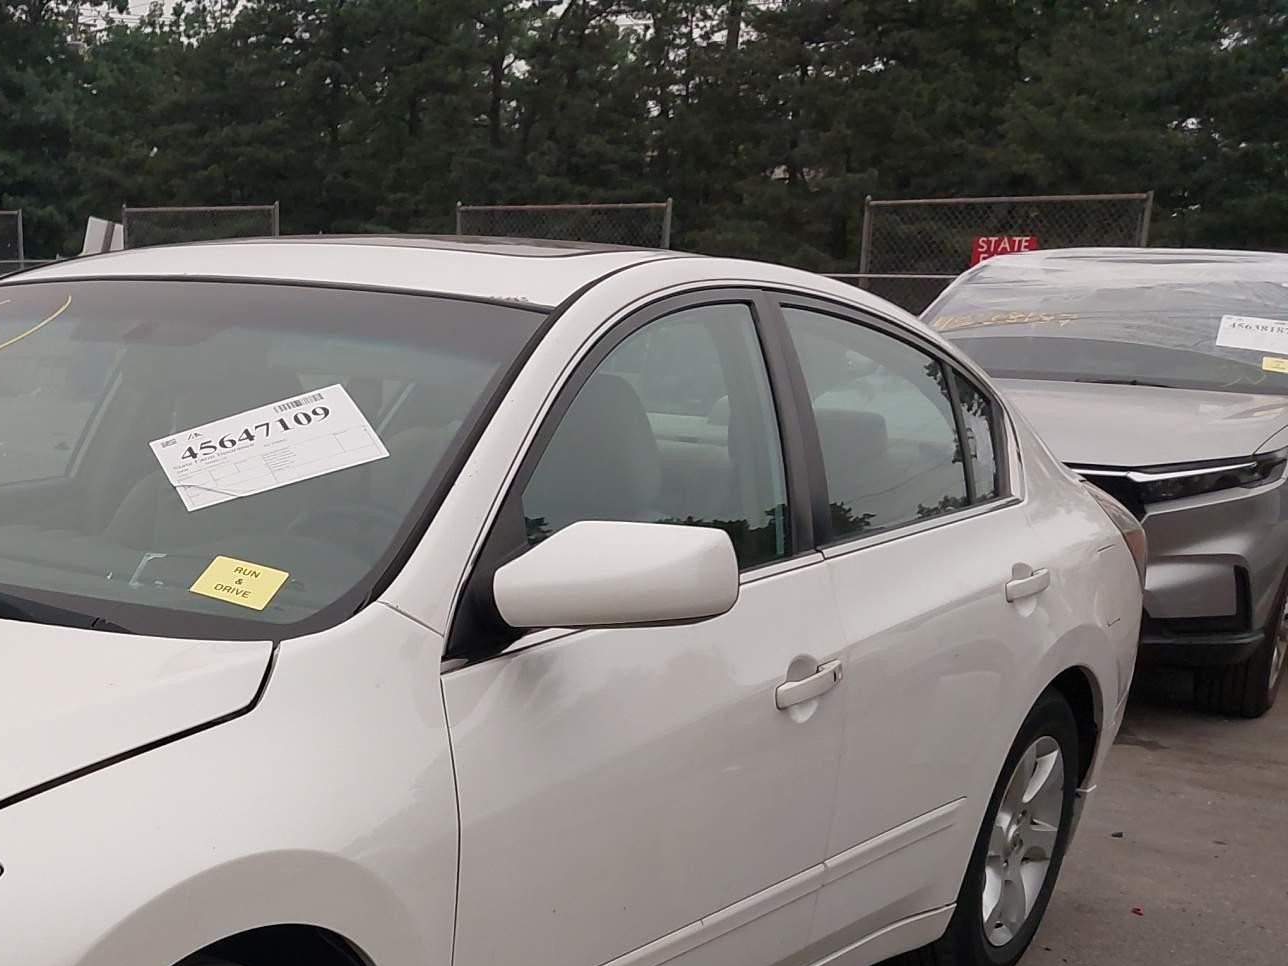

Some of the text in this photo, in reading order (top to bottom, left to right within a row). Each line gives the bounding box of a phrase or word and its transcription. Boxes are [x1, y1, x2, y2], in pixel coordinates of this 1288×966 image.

[977, 236, 1031, 252] STATE
[181, 406, 330, 460] 45647109
[233, 566, 261, 578] RUN
[214, 583, 252, 599] DRIVE
